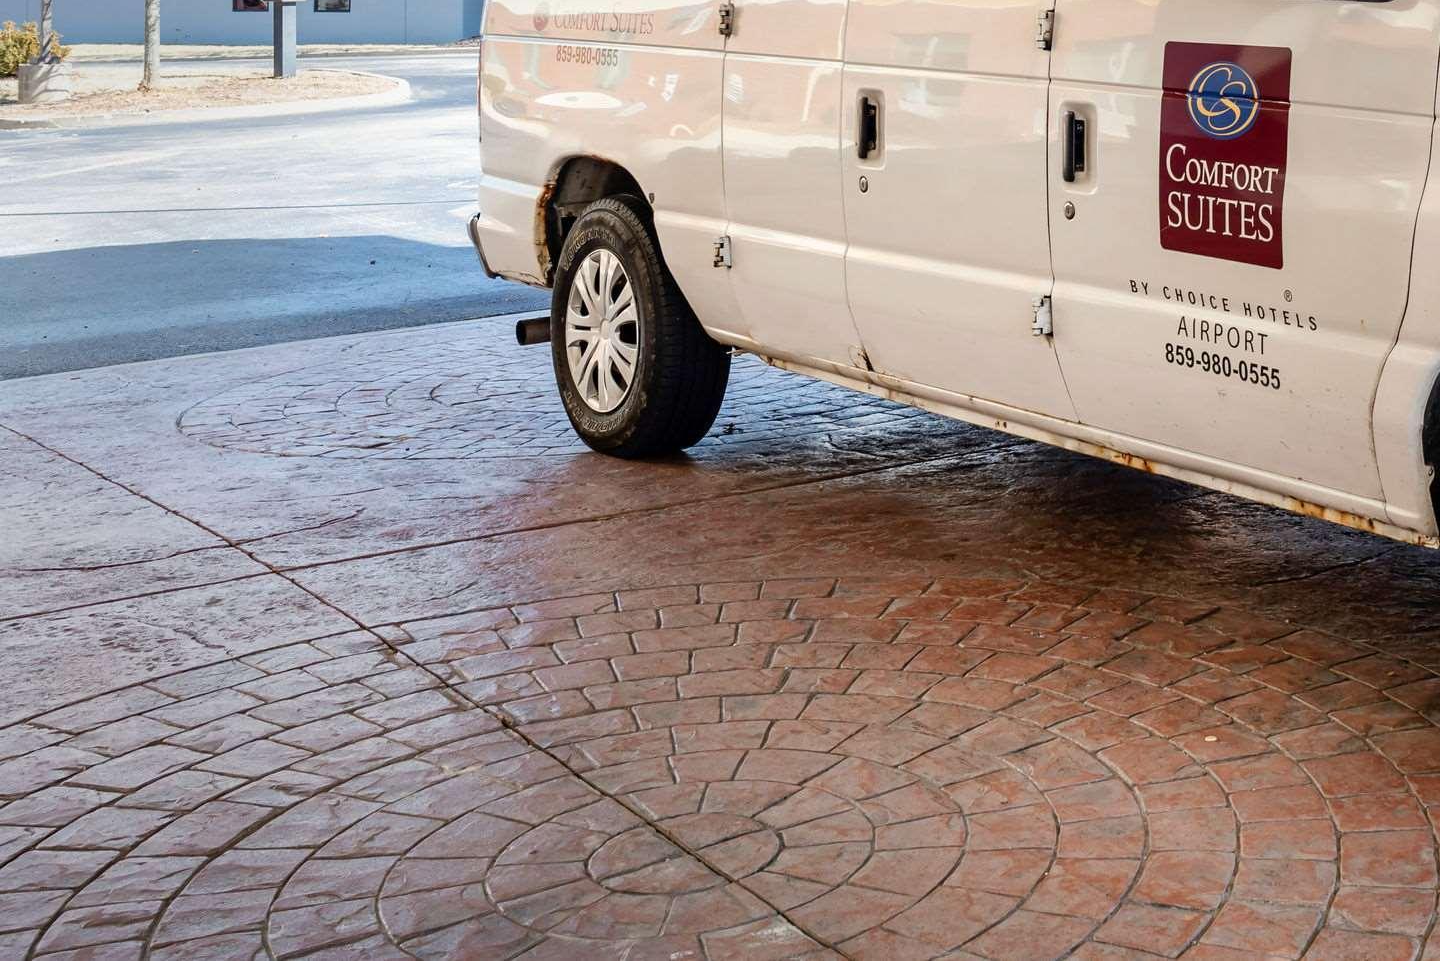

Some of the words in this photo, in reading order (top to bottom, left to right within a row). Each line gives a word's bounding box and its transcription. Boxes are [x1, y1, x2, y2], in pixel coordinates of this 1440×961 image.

[556, 44, 619, 67] 859-980-0555
[1166, 144, 1278, 194] COMFORT
[1167, 190, 1274, 242] SUITES
[1129, 279, 1149, 295] BY
[1162, 286, 1231, 312] CHOICE
[1243, 302, 1318, 331] HOTELS
[1177, 315, 1269, 355] AIRPORT
[1165, 342, 1281, 390] 859-980-0555
